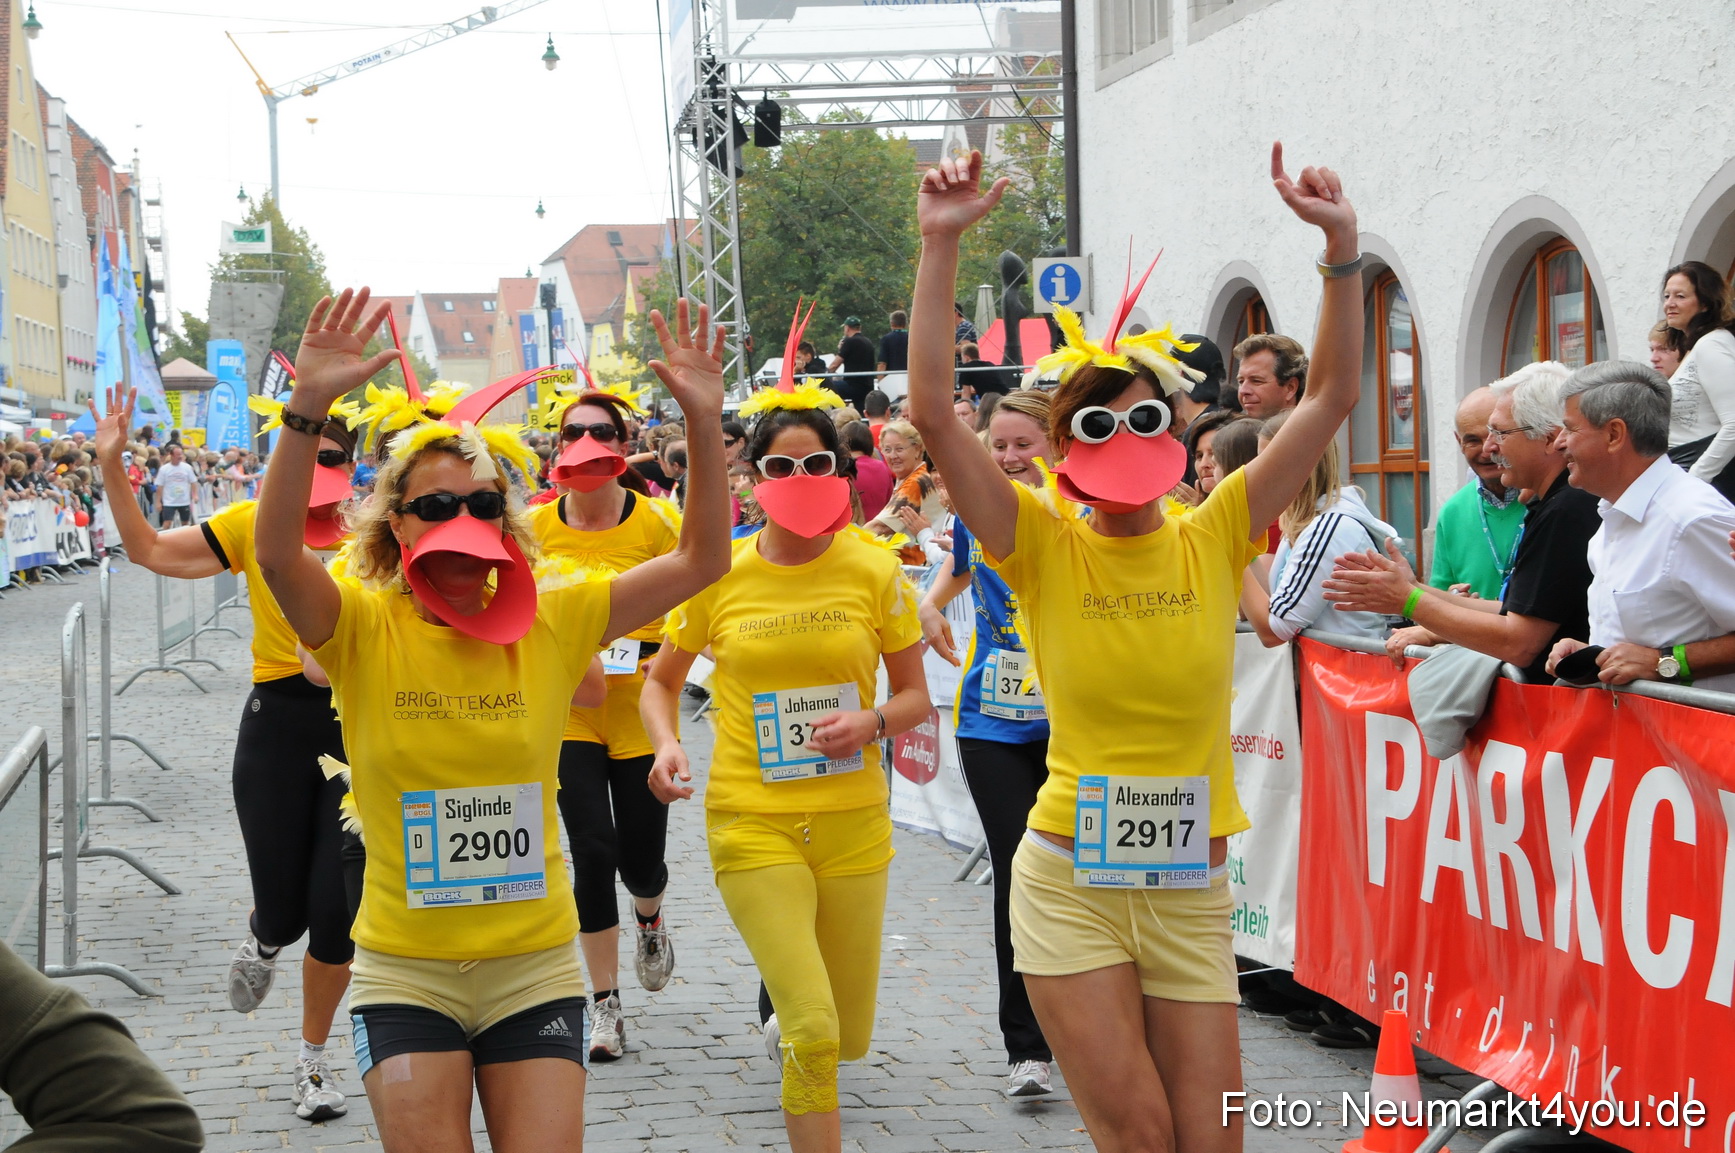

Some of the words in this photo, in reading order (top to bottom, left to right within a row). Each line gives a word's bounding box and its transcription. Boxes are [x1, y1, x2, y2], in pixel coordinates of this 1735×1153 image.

[352, 53, 381, 68] POTAIN
[541, 372, 573, 385] Block
[738, 610, 851, 633] BRIGITTEKARL
[737, 629, 788, 642] cosmetic
[1001, 656, 1019, 671] Tina
[394, 691, 525, 710] BRIGITTEKARL
[784, 696, 839, 714] Johanna
[393, 710, 455, 721] cosmetic
[763, 725, 770, 738] D
[827, 757, 862, 768] PFLEIDERER
[1115, 785, 1194, 806] Alexandra
[445, 795, 512, 823] Siglinde
[1085, 816, 1093, 831] D
[1116, 819, 1196, 848] 2917
[414, 833, 423, 849] D
[449, 827, 530, 863] 2900
[1160, 870, 1207, 881] PFLEIDERER
[423, 891, 462, 902] BOCK
[498, 880, 544, 894] PFLEIDERER
[538, 1028, 573, 1038] adidas
